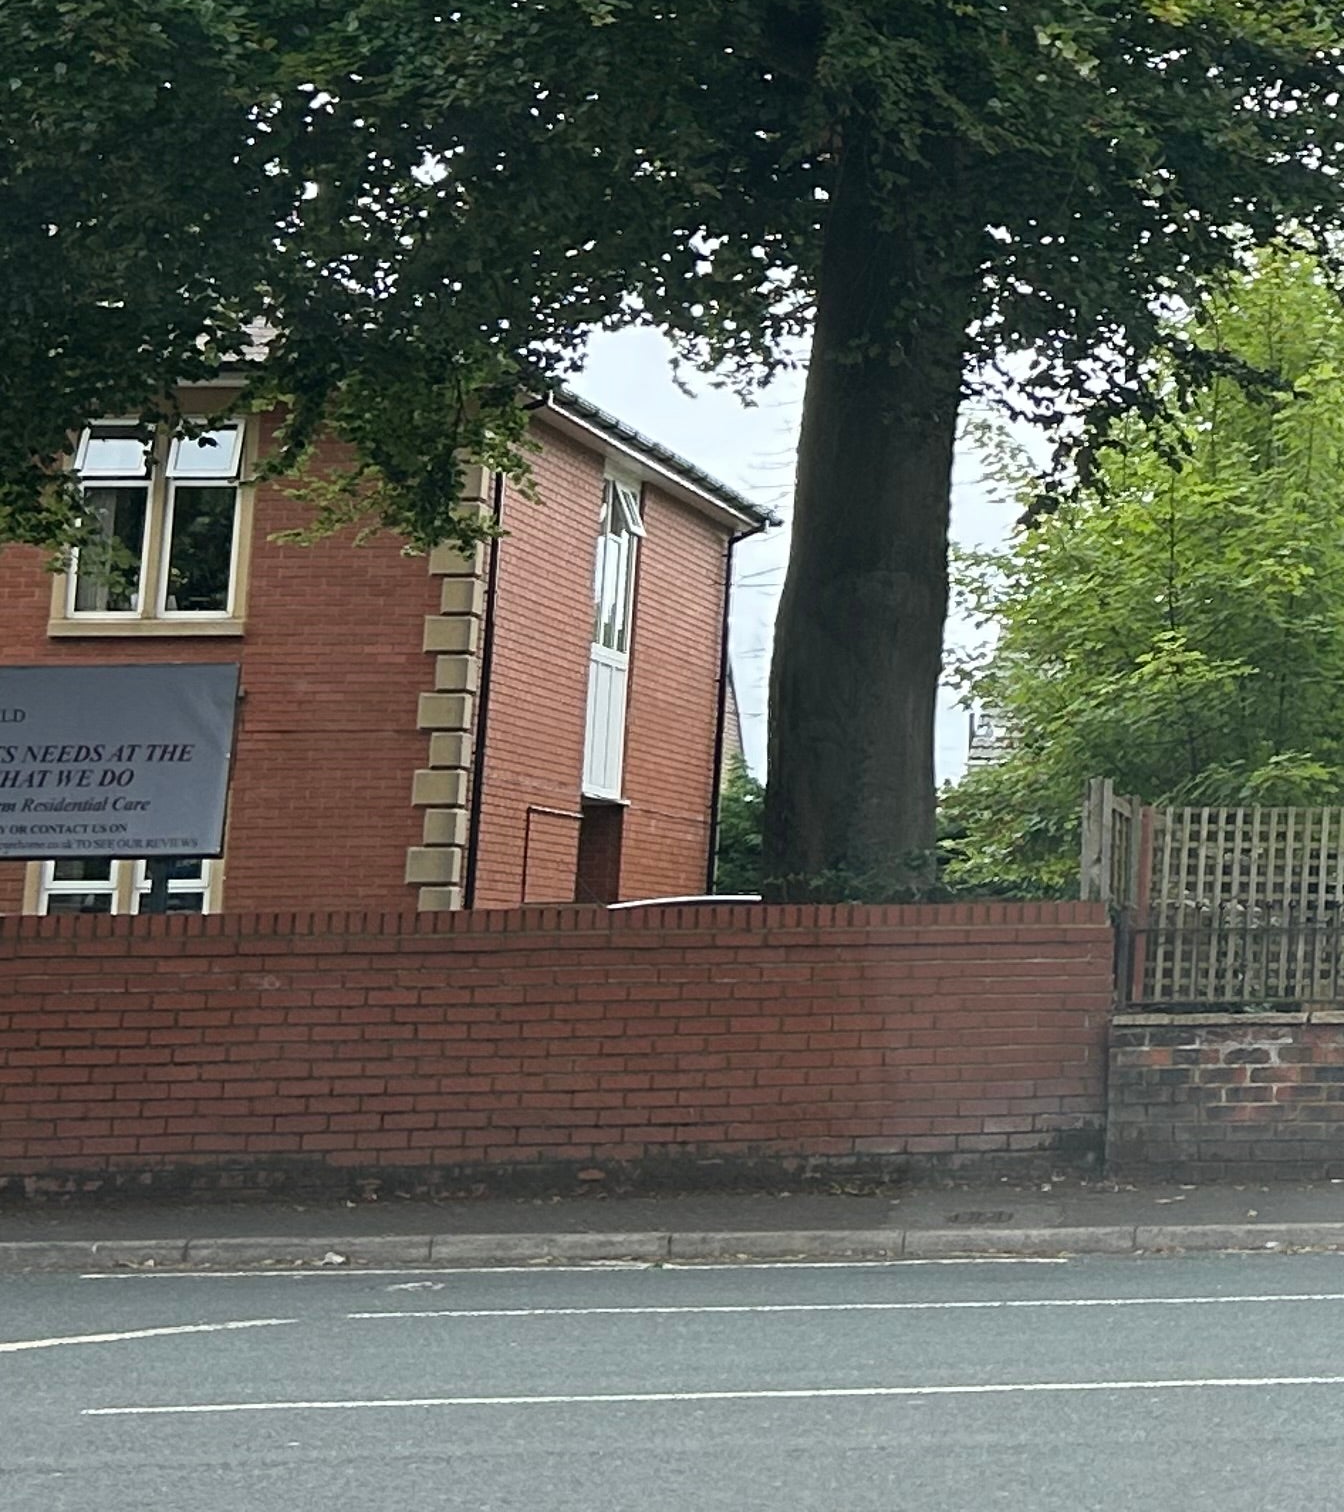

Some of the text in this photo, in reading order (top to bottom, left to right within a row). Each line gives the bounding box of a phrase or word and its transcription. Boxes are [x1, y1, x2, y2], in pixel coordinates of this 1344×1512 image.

[22, 744, 106, 763] NEEDS
[107, 744, 141, 762] AT
[145, 743, 195, 762] THE
[55, 769, 95, 787] WE
[98, 768, 135, 787] DO
[21, 797, 109, 813] Residential
[112, 796, 151, 811] Care
[9, 824, 27, 835] OR
[30, 824, 88, 835] CONTACT
[91, 824, 107, 834] US
[109, 823, 128, 834] ON
[75, 839, 92, 849] TO
